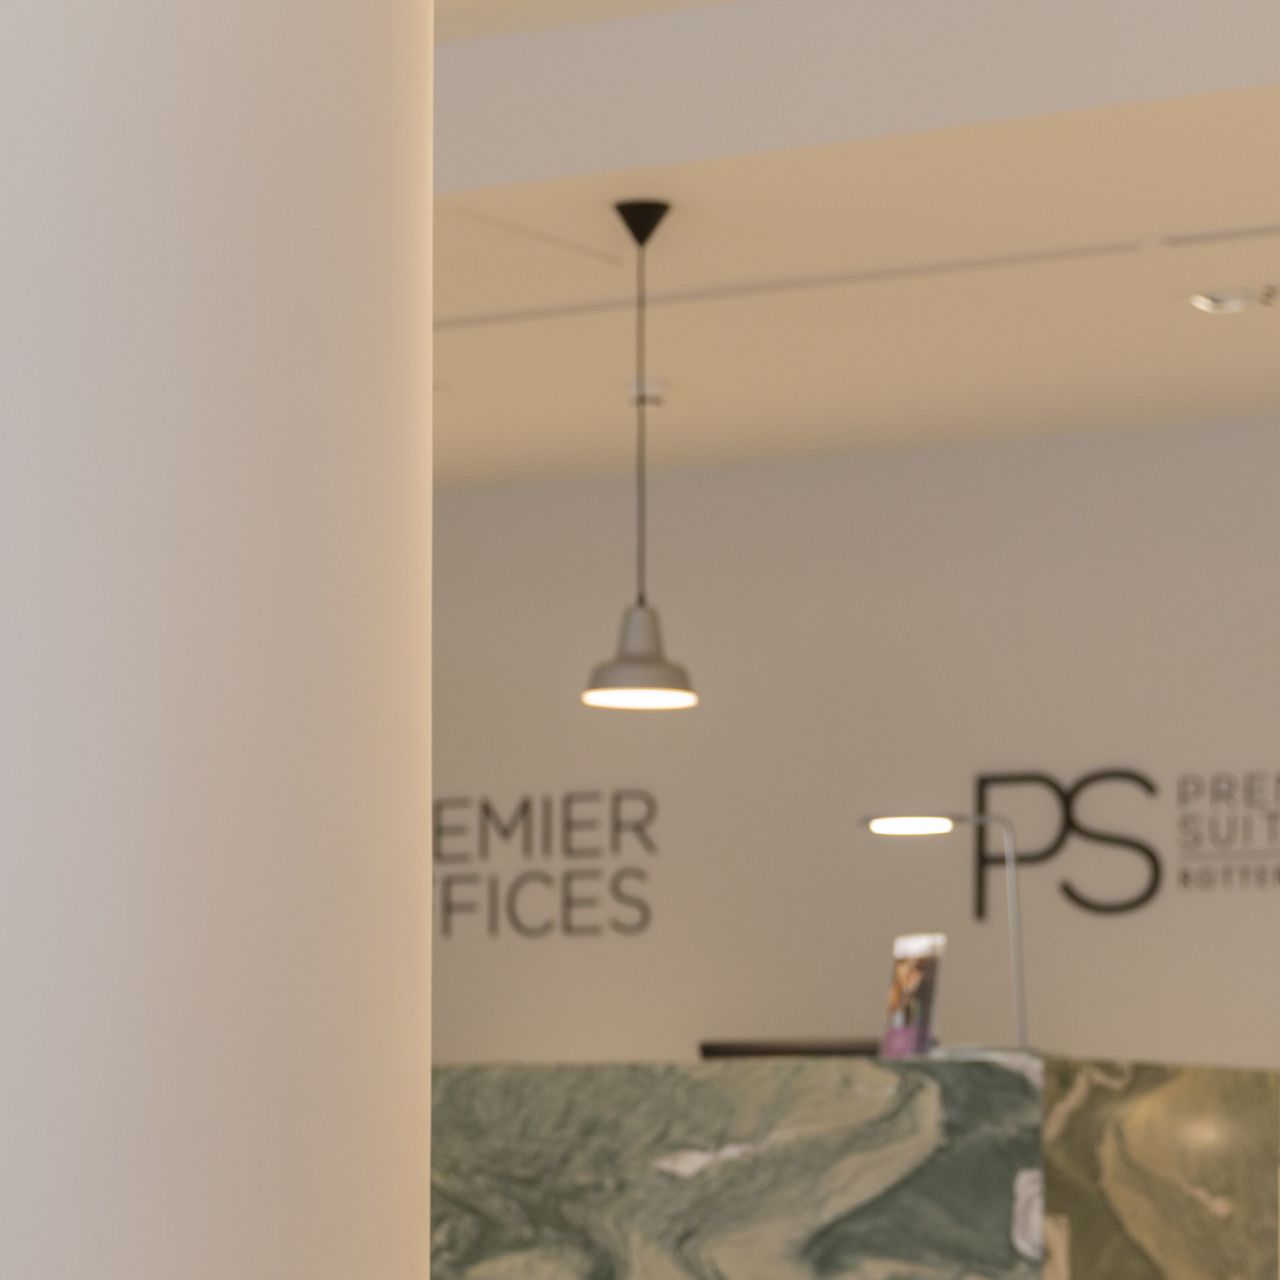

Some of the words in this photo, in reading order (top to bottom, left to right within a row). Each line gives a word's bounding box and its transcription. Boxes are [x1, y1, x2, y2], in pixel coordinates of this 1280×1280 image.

[432, 789, 658, 864] EMIER
[974, 767, 1162, 921] PS
[440, 867, 652, 938] FICES
